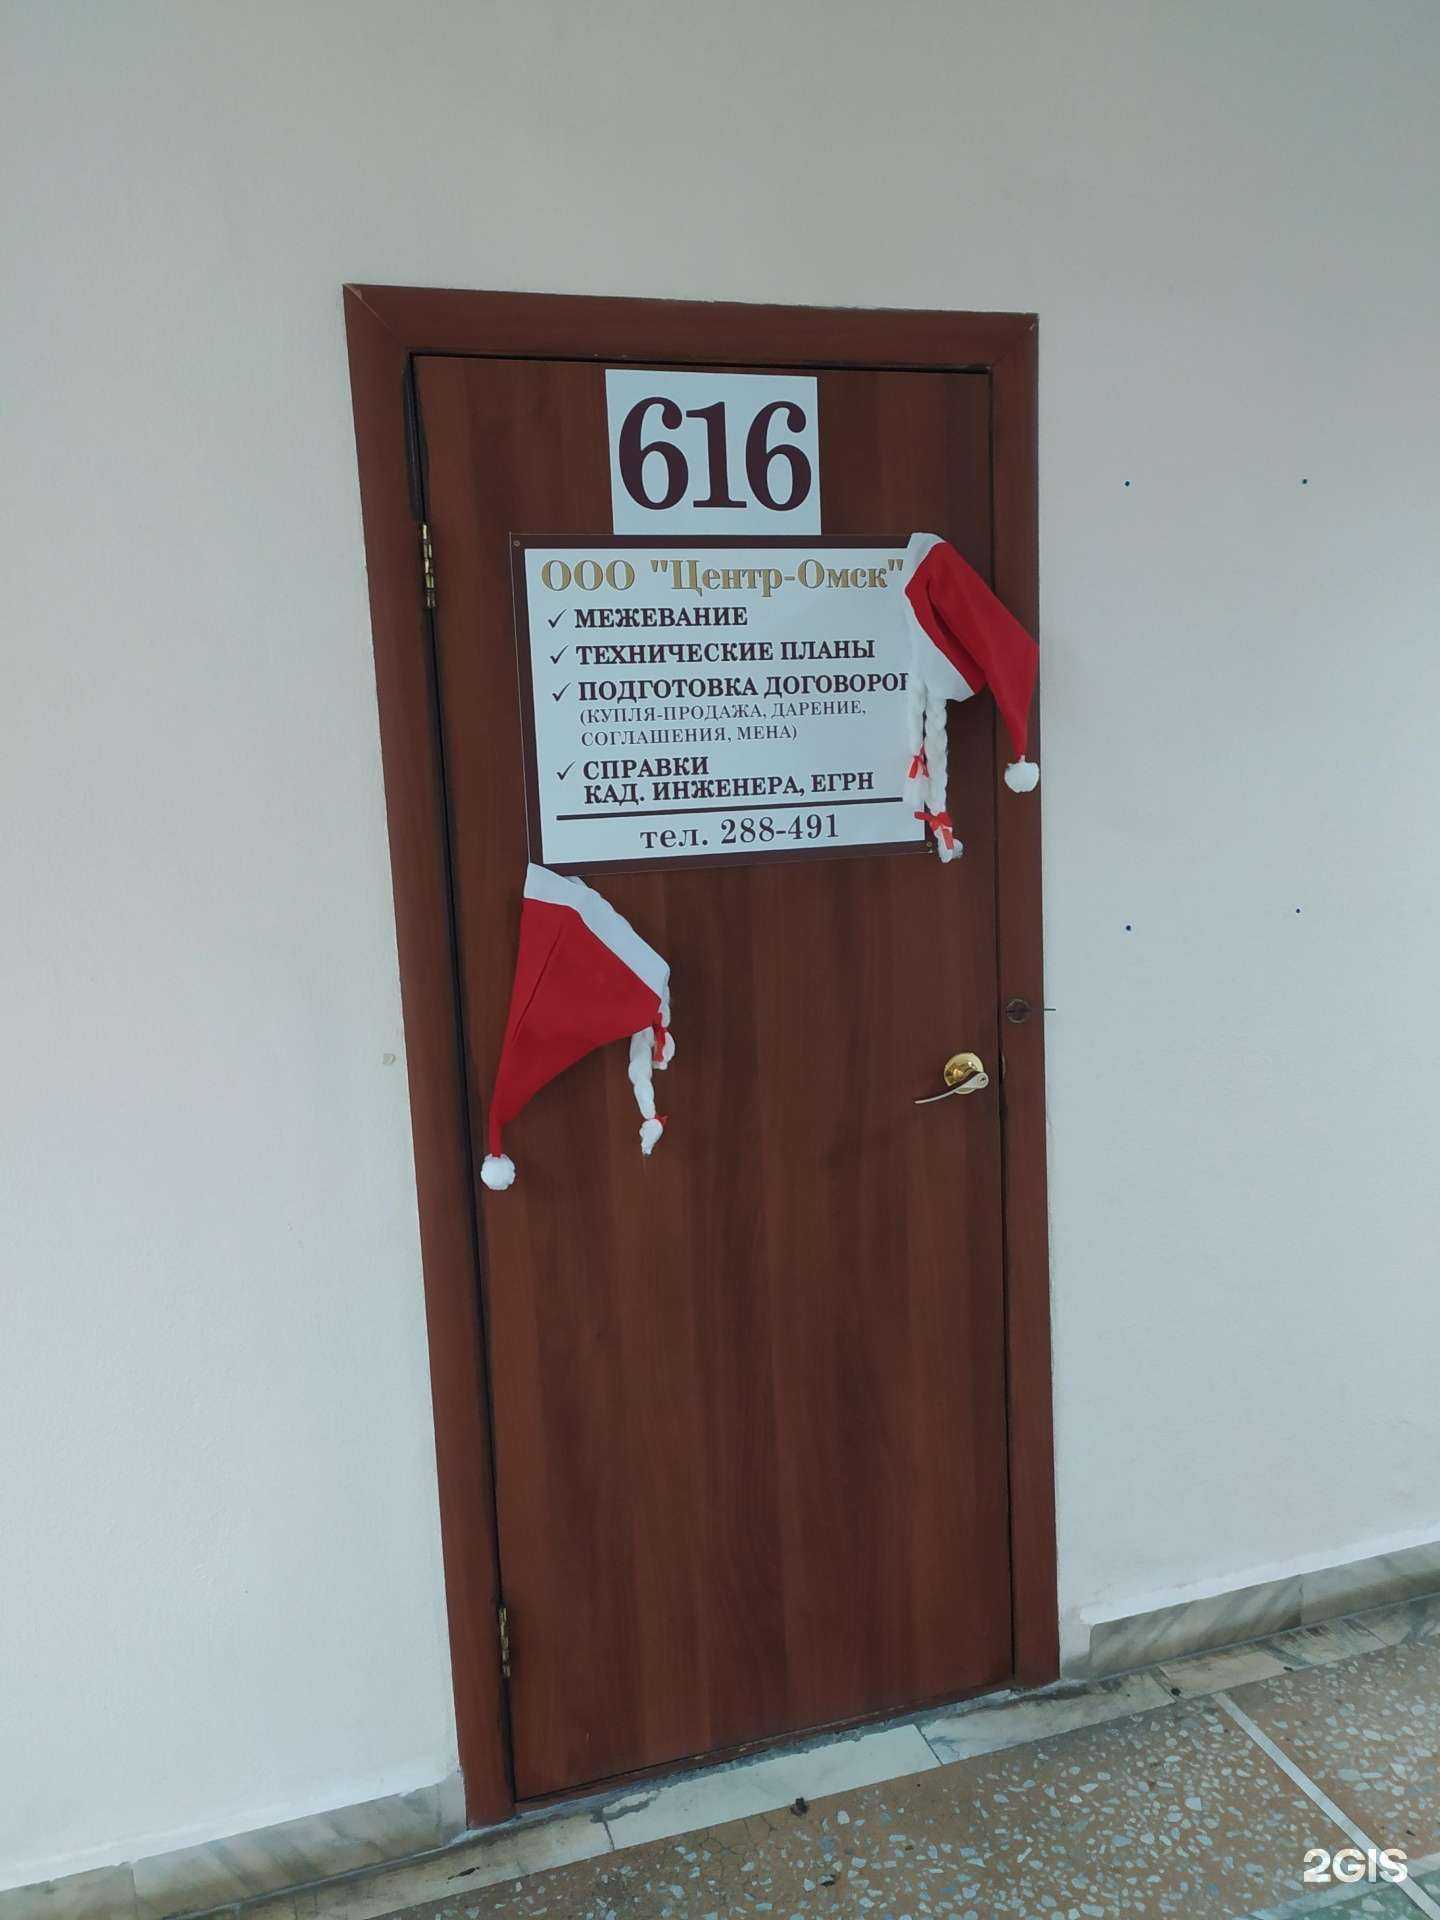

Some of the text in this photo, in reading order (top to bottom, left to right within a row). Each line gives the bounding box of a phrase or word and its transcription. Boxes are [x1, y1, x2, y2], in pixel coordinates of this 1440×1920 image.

[618, 396, 812, 512] 616
[541, 557, 904, 597] ООО "Центр-Омск"
[574, 607, 748, 629] МЕЖЕВАНИЕ
[575, 640, 876, 666] ТЕХНИЧЕСКИЕ ПЛАНЫ
[578, 676, 757, 705] ПОДГОТОВКА
[770, 700, 867, 719] ДАРЕНИЕ,
[581, 724, 798, 747] СОГЛАШЕНИЯ, МЕНА)
[583, 756, 709, 780] СПРАВКИ
[583, 772, 874, 806] КАД. ИНЖЕНЕРА, ЕГРН
[639, 813, 839, 849] тел. 288-491
